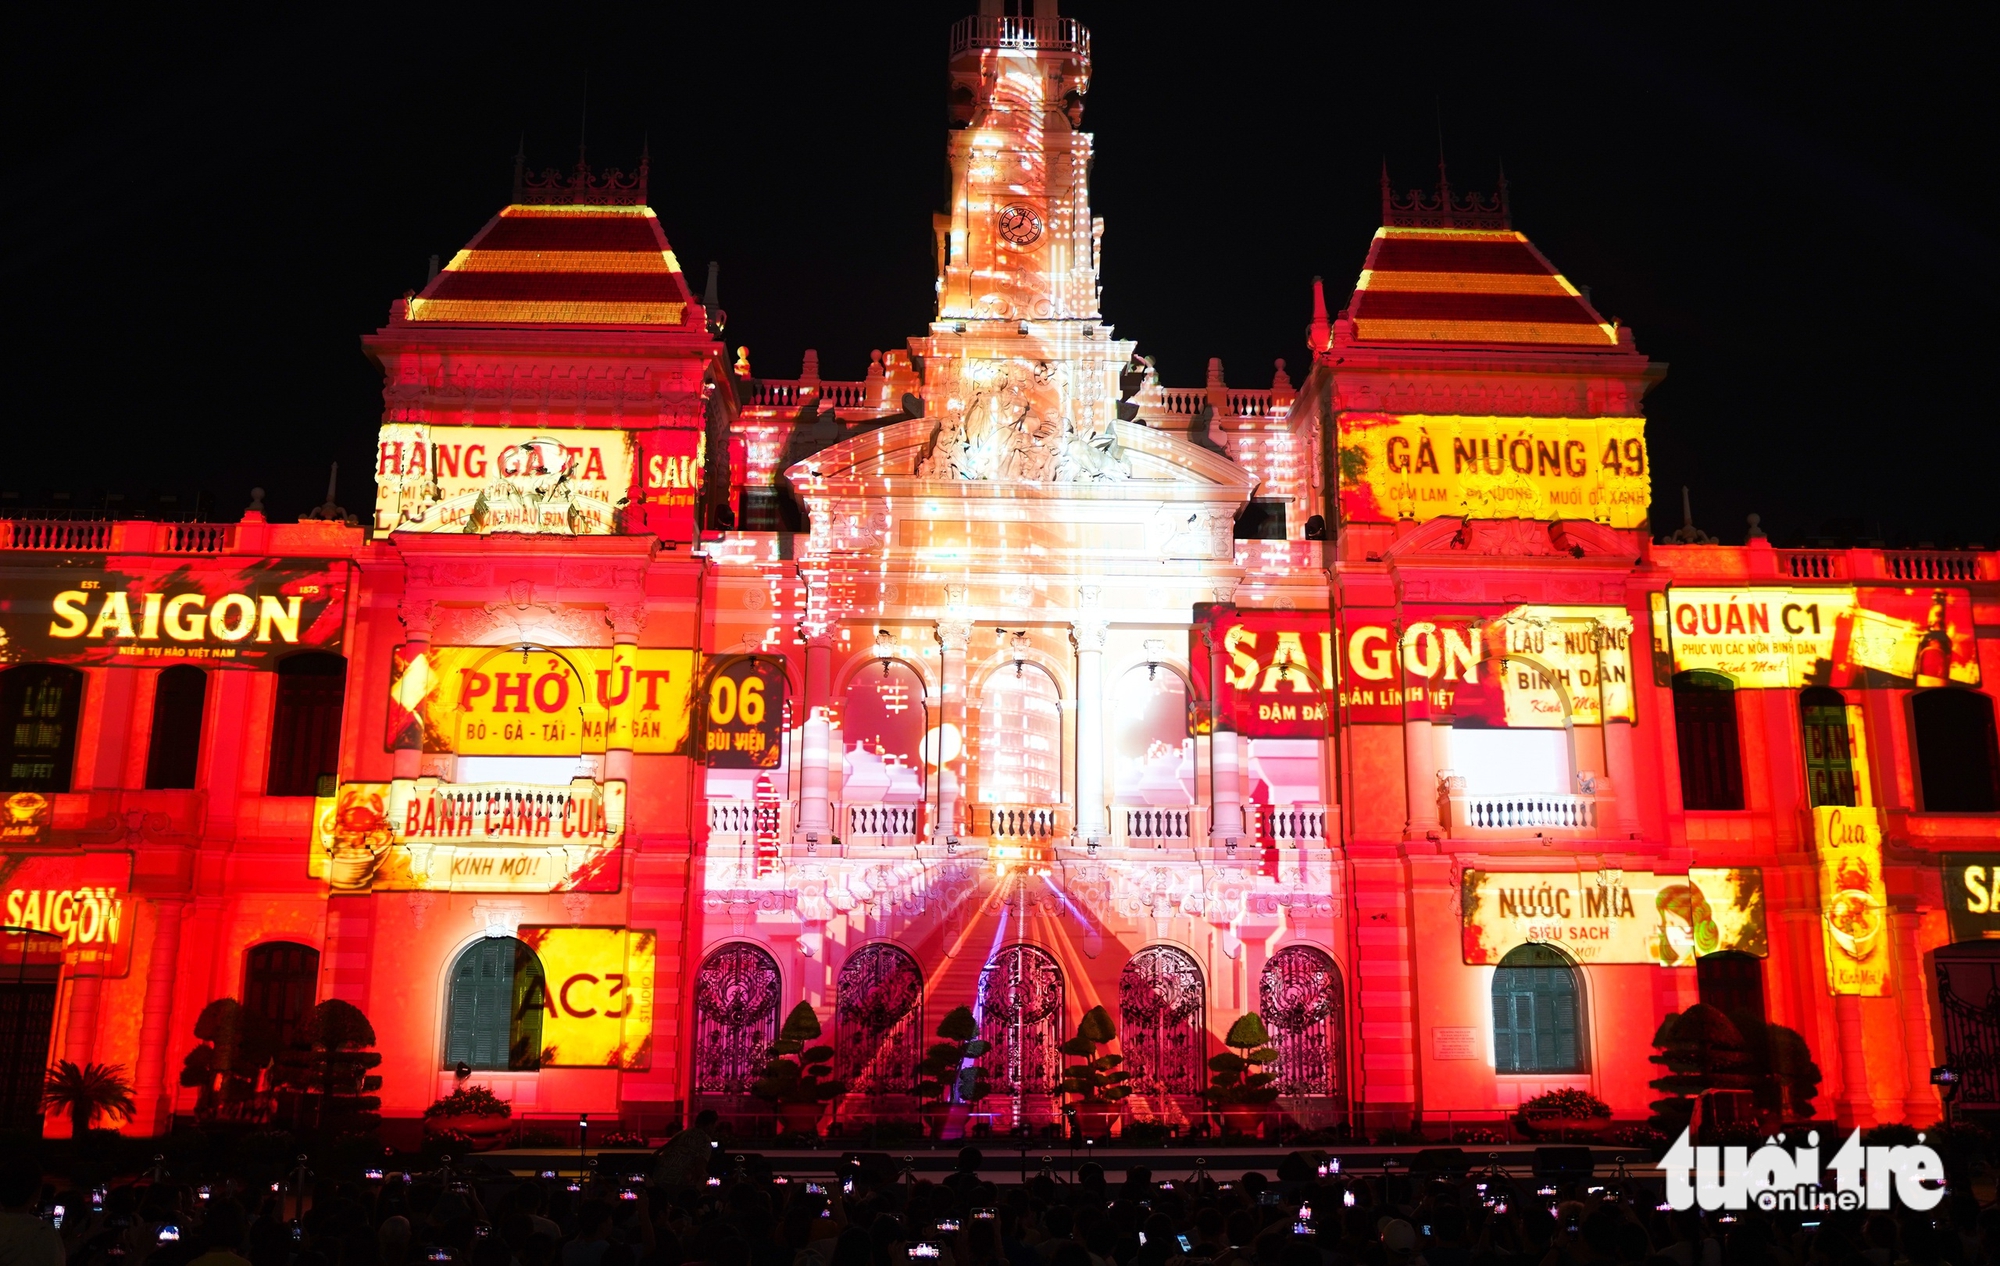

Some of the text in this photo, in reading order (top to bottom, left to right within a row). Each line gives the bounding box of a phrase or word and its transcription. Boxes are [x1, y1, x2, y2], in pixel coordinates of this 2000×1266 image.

[378, 431, 488, 478] HÀNG
[558, 443, 607, 481] TA
[1387, 427, 1645, 478] GÀ NƯỚNG 49
[1421, 487, 1448, 502] LAM
[81, 580, 101, 590] EST.
[49, 590, 304, 643] SAIGON
[1675, 595, 1821, 637] QUÁN C1
[148, 647, 162, 658] TỰ
[164, 646, 186, 657] HÀO
[212, 648, 236, 658] NAM
[1224, 621, 1482, 694] SAIGON
[459, 654, 670, 713] PHỞ ÚT
[1579, 660, 1626, 687] DÂN
[709, 676, 765, 725] 06
[1259, 702, 1296, 724] ĐẬM
[1302, 701, 1329, 721] ĐÀ
[1340, 686, 1375, 707] BẢN
[466, 719, 486, 740] BÒ
[504, 719, 525, 741] GÀ
[542, 719, 566, 742] TÁI
[404, 788, 475, 838] BÁNH
[561, 797, 608, 840] CUA
[1828, 809, 1867, 848] Cua
[452, 851, 541, 876] KÍNH MỜI!
[4, 887, 122, 946] SAIGON
[1499, 878, 1636, 918] NƯỚC MÍA
[1569, 926, 1610, 943] SẠCH
[515, 973, 634, 1019] AC3
[640, 976, 652, 1023] STUDIO
